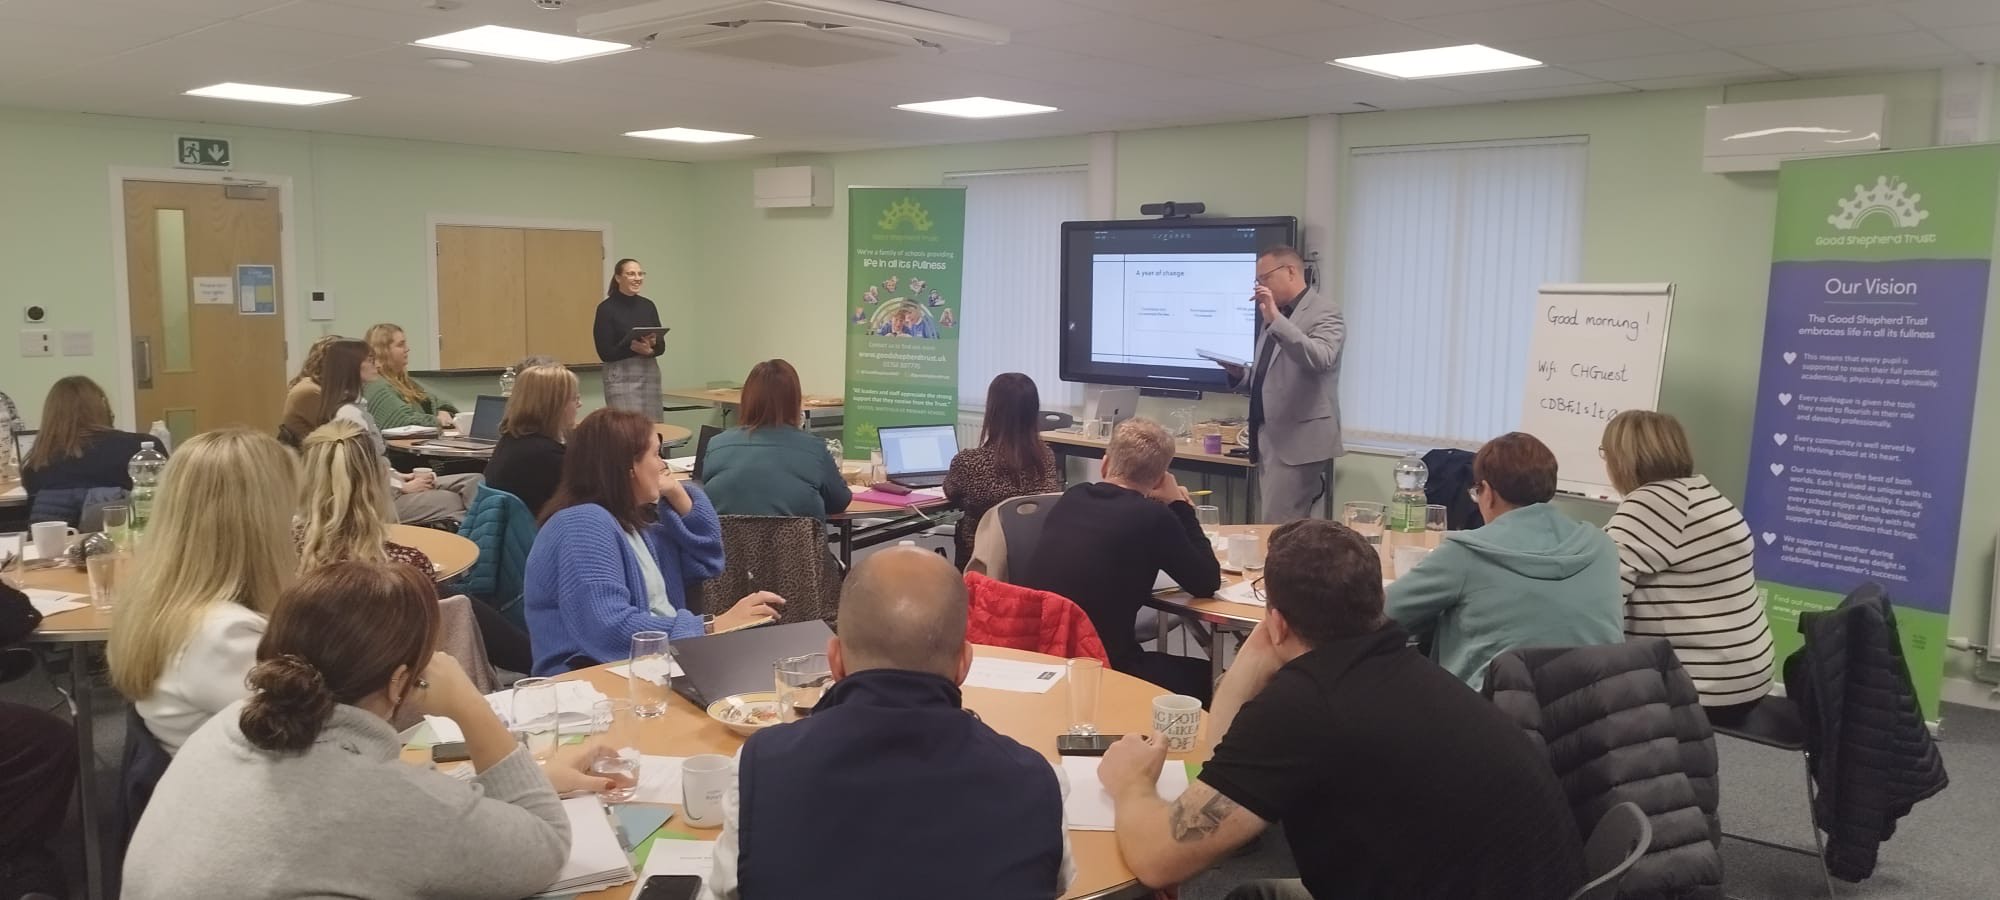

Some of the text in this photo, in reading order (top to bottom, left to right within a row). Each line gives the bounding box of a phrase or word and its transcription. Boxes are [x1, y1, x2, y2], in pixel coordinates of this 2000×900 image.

[1816, 234, 1936, 248] Good Shepherd Trust
[1163, 270, 1184, 278] change
[1825, 278, 1918, 295] Our Vision
[1548, 306, 1579, 326] Good
[1808, 314, 1928, 326] The Good Shepherd Trust
[1798, 326, 1936, 339] embraces life in all its fullness
[1882, 356, 1901, 365] pupil
[1538, 360, 1557, 380] Wifi
[1890, 366, 1902, 374] full
[1799, 394, 1818, 402] Every
[1820, 396, 1853, 405] colleague
[1862, 399, 1881, 407] given
[1797, 404, 1814, 412] they
[1844, 406, 1871, 416] flourish
[1872, 408, 1880, 417] in
[1880, 409, 1898, 418] their
[1900, 411, 1915, 419] role
[1811, 415, 1840, 424] develop
[1794, 434, 1814, 444] Every
[1815, 437, 1855, 448] community
[1880, 444, 1905, 452] served
[1906, 444, 1916, 454] by
[1806, 446, 1834, 456] thriving
[1868, 452, 1877, 460] its
[1879, 452, 1901, 462] heart.
[1805, 468, 1832, 476] schools
[1833, 471, 1853, 480] enjoy
[1854, 472, 1867, 480] the
[1868, 473, 1884, 482] best
[1895, 477, 1912, 486] both
[1805, 488, 1832, 496] context
[1817, 478, 1834, 487] Each
[1842, 482, 1866, 490] valued
[1877, 487, 1903, 496] unique
[1904, 489, 1921, 497] with
[1922, 491, 1932, 499] its
[1788, 496, 1807, 504] every
[1808, 498, 1832, 506] school
[1832, 502, 1855, 510] enjoys
[1881, 506, 1910, 517] benefits
[1786, 504, 1820, 516] belonging
[1837, 511, 1859, 521] bigger
[1861, 514, 1884, 525] family
[1885, 518, 1902, 526] with
[1903, 520, 1916, 529] the
[1786, 515, 1813, 525] support
[1814, 518, 1828, 526] and
[1829, 521, 1875, 533] collaboration
[1877, 527, 1892, 536] that
[1783, 534, 1795, 543] We
[1796, 537, 1823, 547] support
[1839, 544, 1869, 554] another
[1870, 548, 1894, 560] during
[1781, 554, 1820, 568] celebrating
[1782, 544, 1794, 552] the
[1823, 551, 1842, 560] times
[1844, 555, 1858, 563] and
[1871, 559, 1897, 570] delight
[1898, 563, 1906, 571] in
[1774, 594, 1790, 604] Find
[1804, 601, 1823, 610] more
